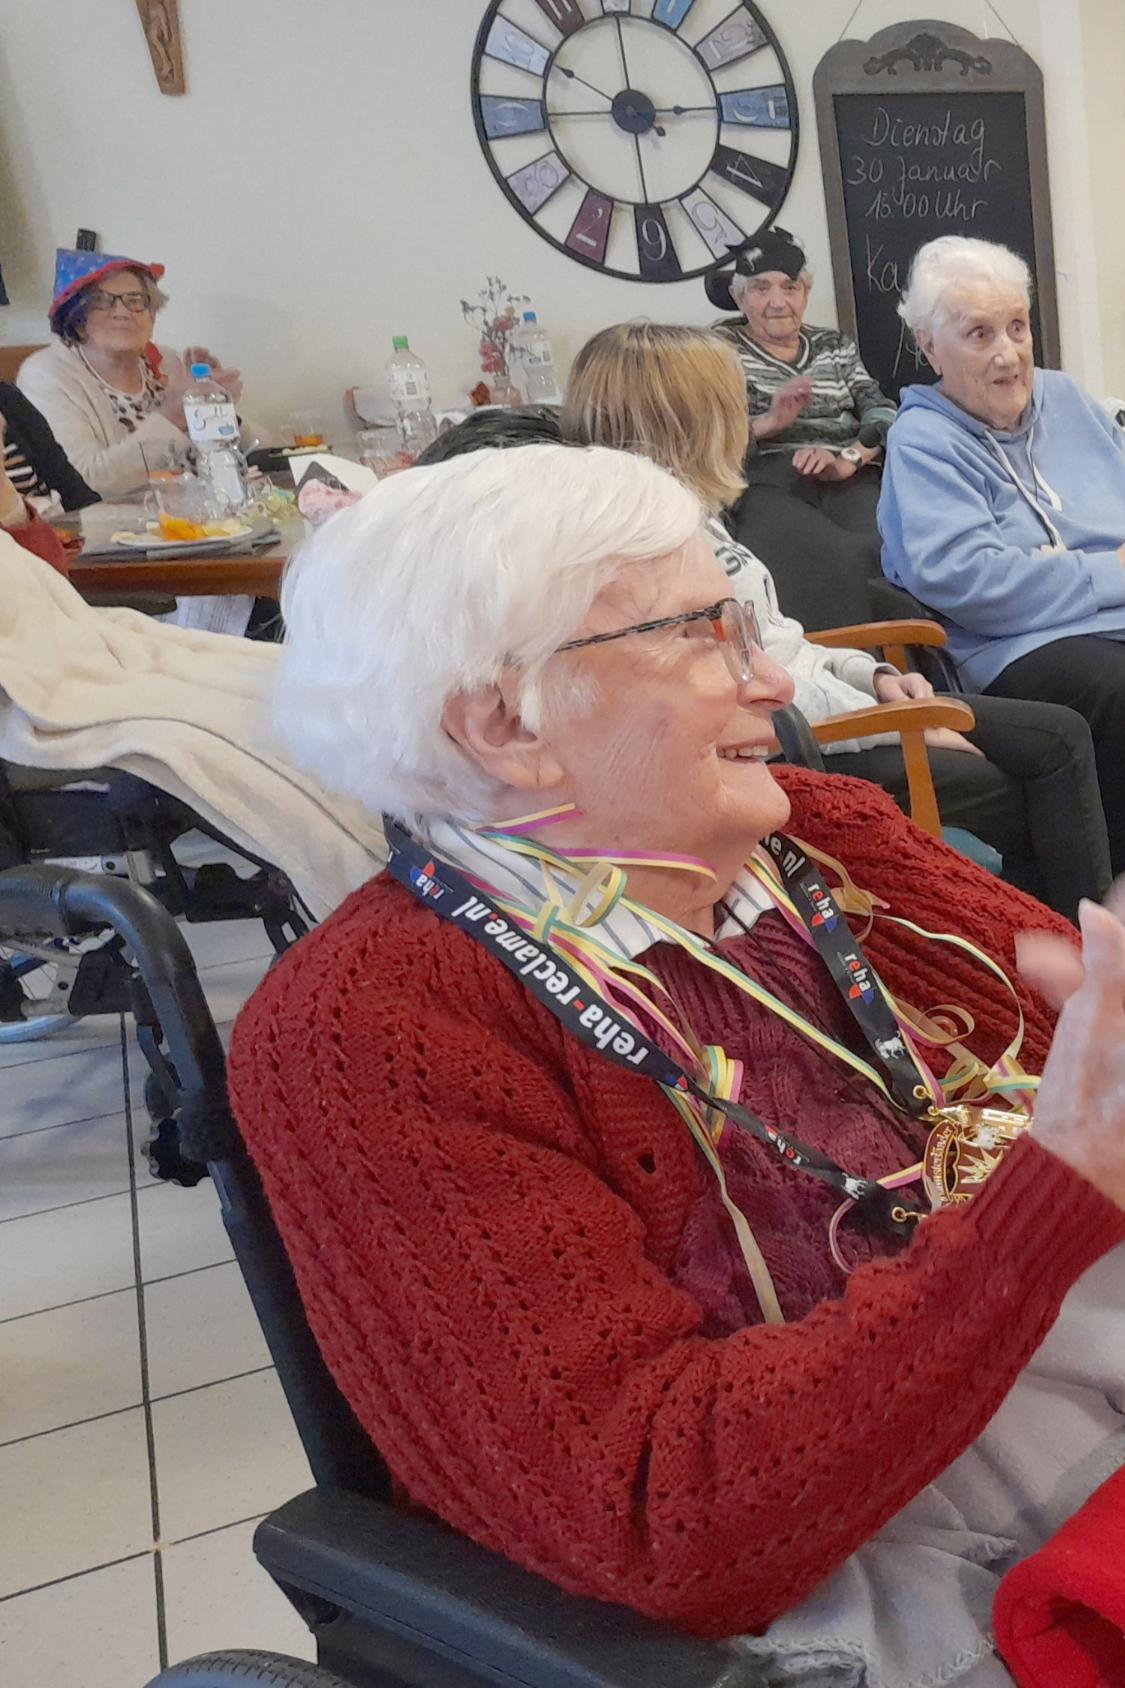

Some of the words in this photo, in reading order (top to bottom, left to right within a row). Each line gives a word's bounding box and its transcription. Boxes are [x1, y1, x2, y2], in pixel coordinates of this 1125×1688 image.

[862, 106, 985, 175] Dienstag
[725, 155, 769, 192] 4
[891, 155, 1002, 205] Januar
[934, 189, 989, 221] Uhr
[415, 873, 445, 900] reha
[807, 883, 834, 919] reha
[450, 895, 650, 1066] reha-reclame.nl
[843, 953, 872, 992] reha
